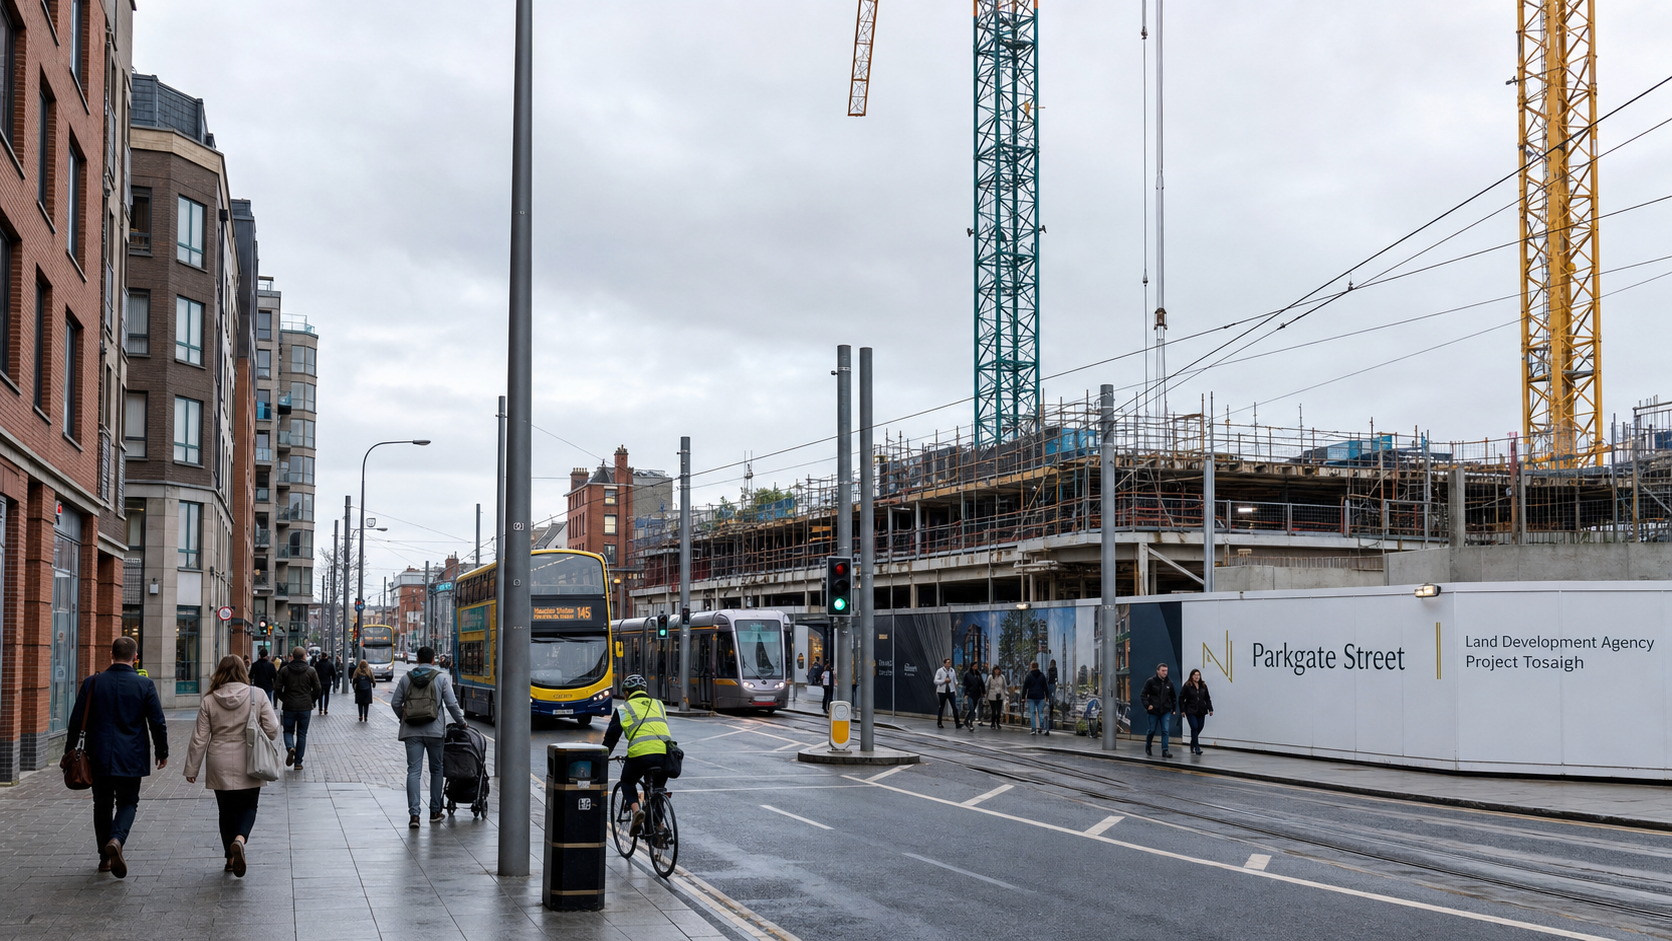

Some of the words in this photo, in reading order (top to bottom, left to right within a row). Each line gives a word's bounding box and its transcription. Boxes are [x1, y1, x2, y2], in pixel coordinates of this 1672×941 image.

[576, 606, 591, 619] 145
[1465, 635, 1498, 648] Land
[1502, 635, 1598, 652] Development
[1601, 635, 1655, 653] Agency
[1252, 641, 1337, 677] Parkgate
[1343, 642, 1406, 671] Street
[1466, 655, 1518, 671] Project
[1523, 655, 1584, 672] Tosaigh
